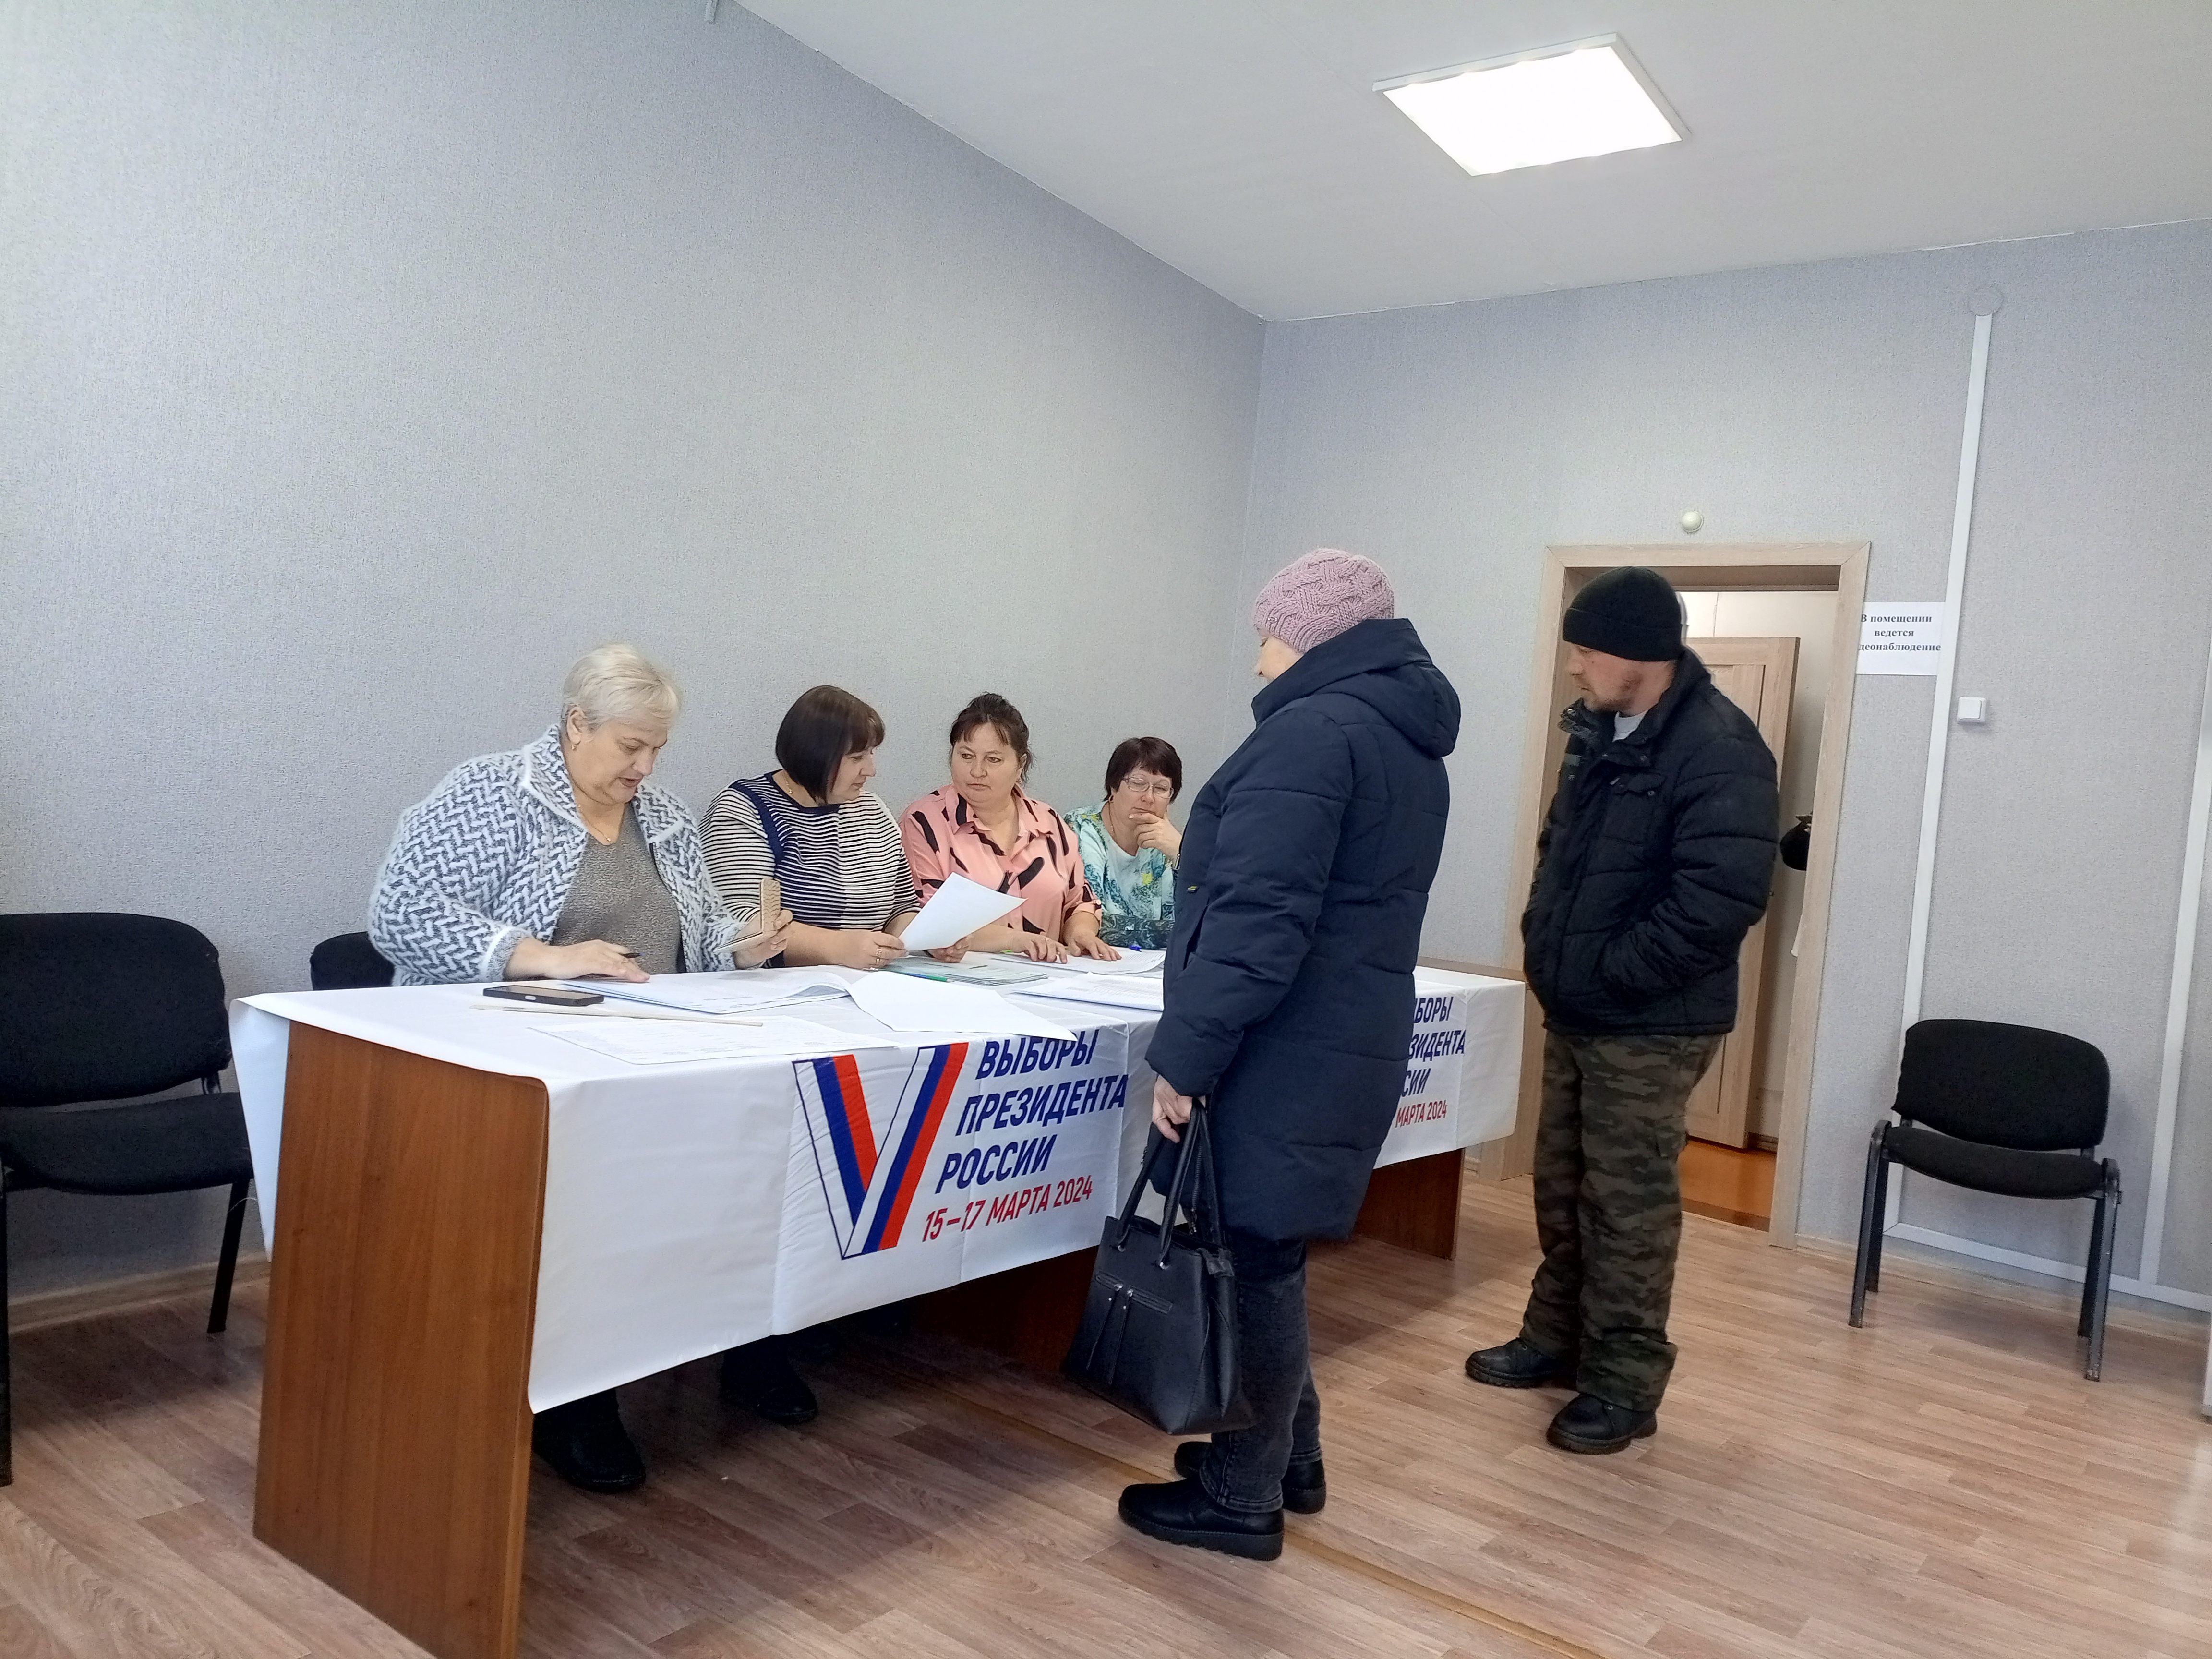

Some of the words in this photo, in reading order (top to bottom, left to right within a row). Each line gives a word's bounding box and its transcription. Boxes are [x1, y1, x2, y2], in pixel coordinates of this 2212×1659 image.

[1861, 614, 1867, 622] В
[1859, 642, 1941, 651] деонаблюдение
[1414, 996, 1454, 1023] БОРЫ
[975, 1029, 1100, 1080] ВЫБОРЫ
[1409, 1029, 1466, 1062] ЗИДЕНТА
[955, 1074, 1129, 1136] ПРЕЗИДЕНТА
[1395, 1102, 1426, 1128] МАРТА
[1426, 1100, 1448, 1121] 2024
[935, 1134, 1058, 1194] РОССИИ
[986, 1184, 1052, 1227] МАРТА
[1054, 1175, 1093, 1208] 2024
